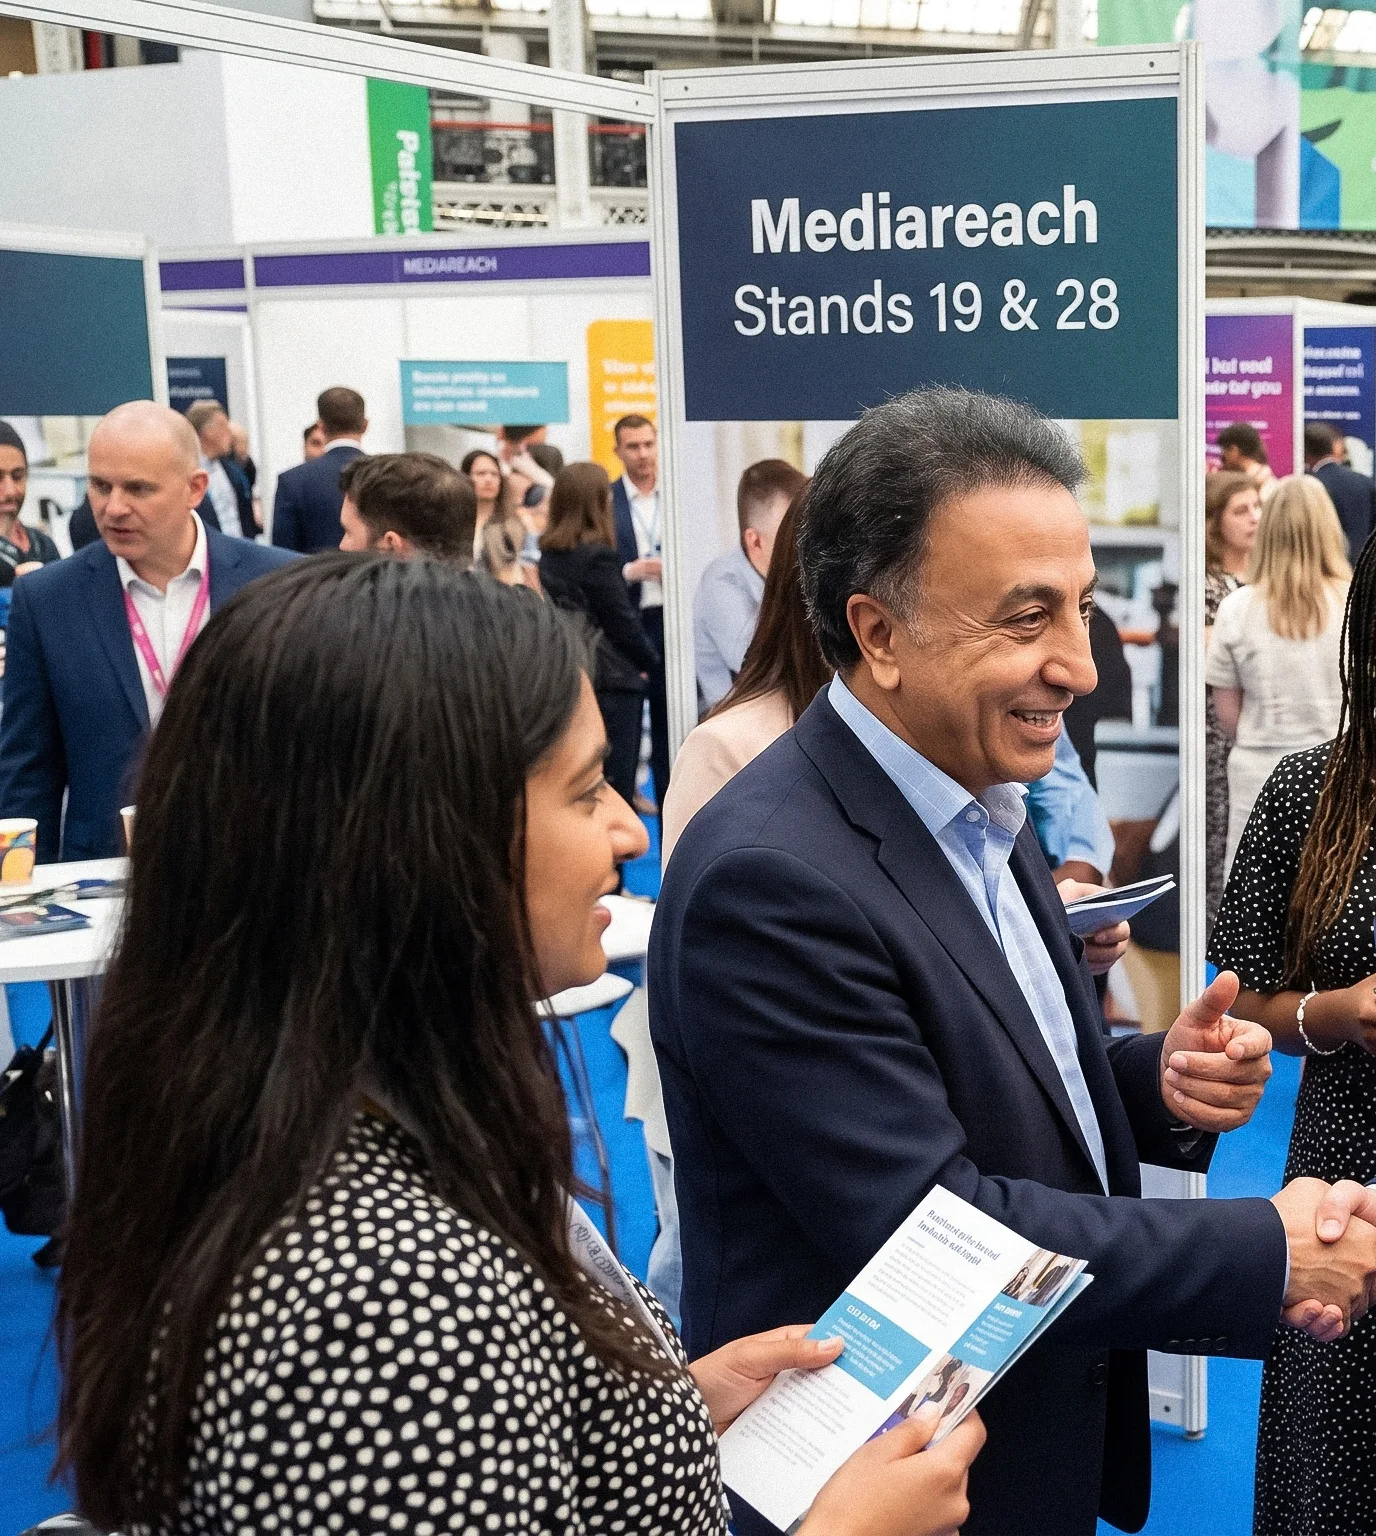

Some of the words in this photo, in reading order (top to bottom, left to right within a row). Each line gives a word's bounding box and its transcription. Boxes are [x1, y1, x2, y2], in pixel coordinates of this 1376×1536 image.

[750, 184, 1098, 254] Mediareach
[403, 256, 498, 275] MEDIAREACH
[734, 279, 914, 336] Stands
[929, 281, 982, 333] 19
[999, 278, 1039, 331] &
[1056, 277, 1120, 331] 28
